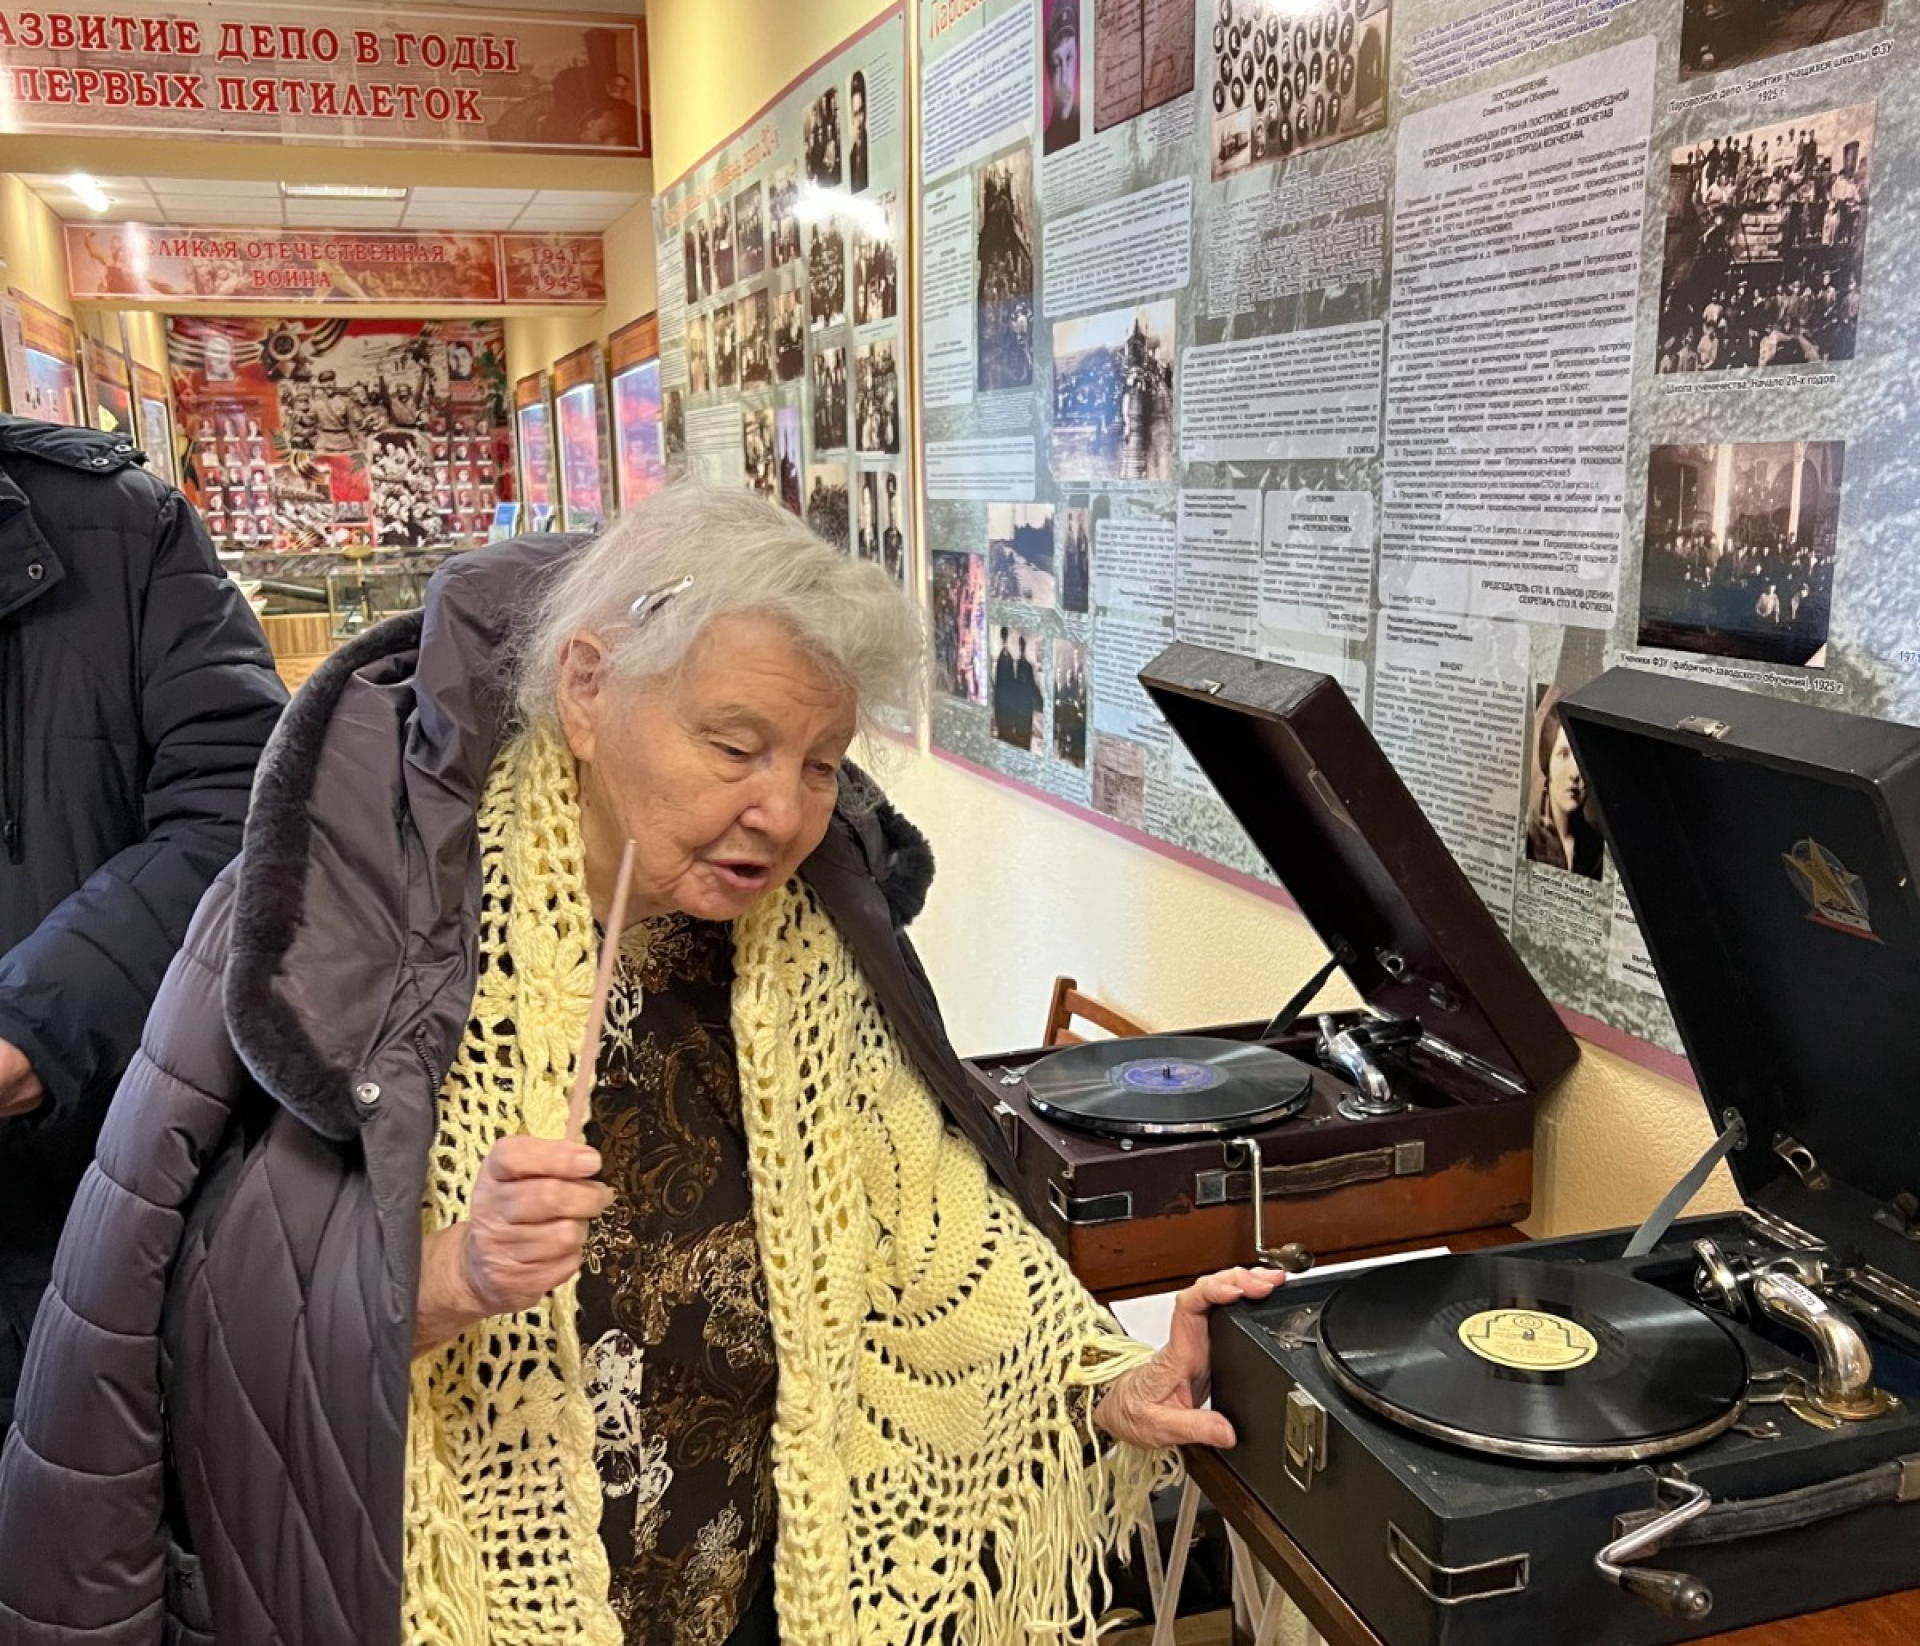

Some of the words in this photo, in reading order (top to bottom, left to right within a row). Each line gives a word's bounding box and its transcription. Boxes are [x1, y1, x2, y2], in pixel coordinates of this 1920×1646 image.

[0, 12, 201, 54] АЗВИТИЕ
[217, 23, 339, 64] ДЕПО
[356, 31, 382, 65] В
[395, 34, 518, 73] ГОДЫ
[1871, 41, 1894, 56] ФЗУ
[11, 67, 202, 109] ПЕРВЫХ
[219, 76, 485, 123] ПЯТИЛЕТОК
[147, 239, 239, 258] ЕЛИКАЯ
[247, 241, 444, 262] ОТЕЧЕСТВЕННАЯ
[531, 248, 581, 265] 1941
[253, 266, 332, 287] ВОЙНА
[532, 275, 581, 291] 1945
